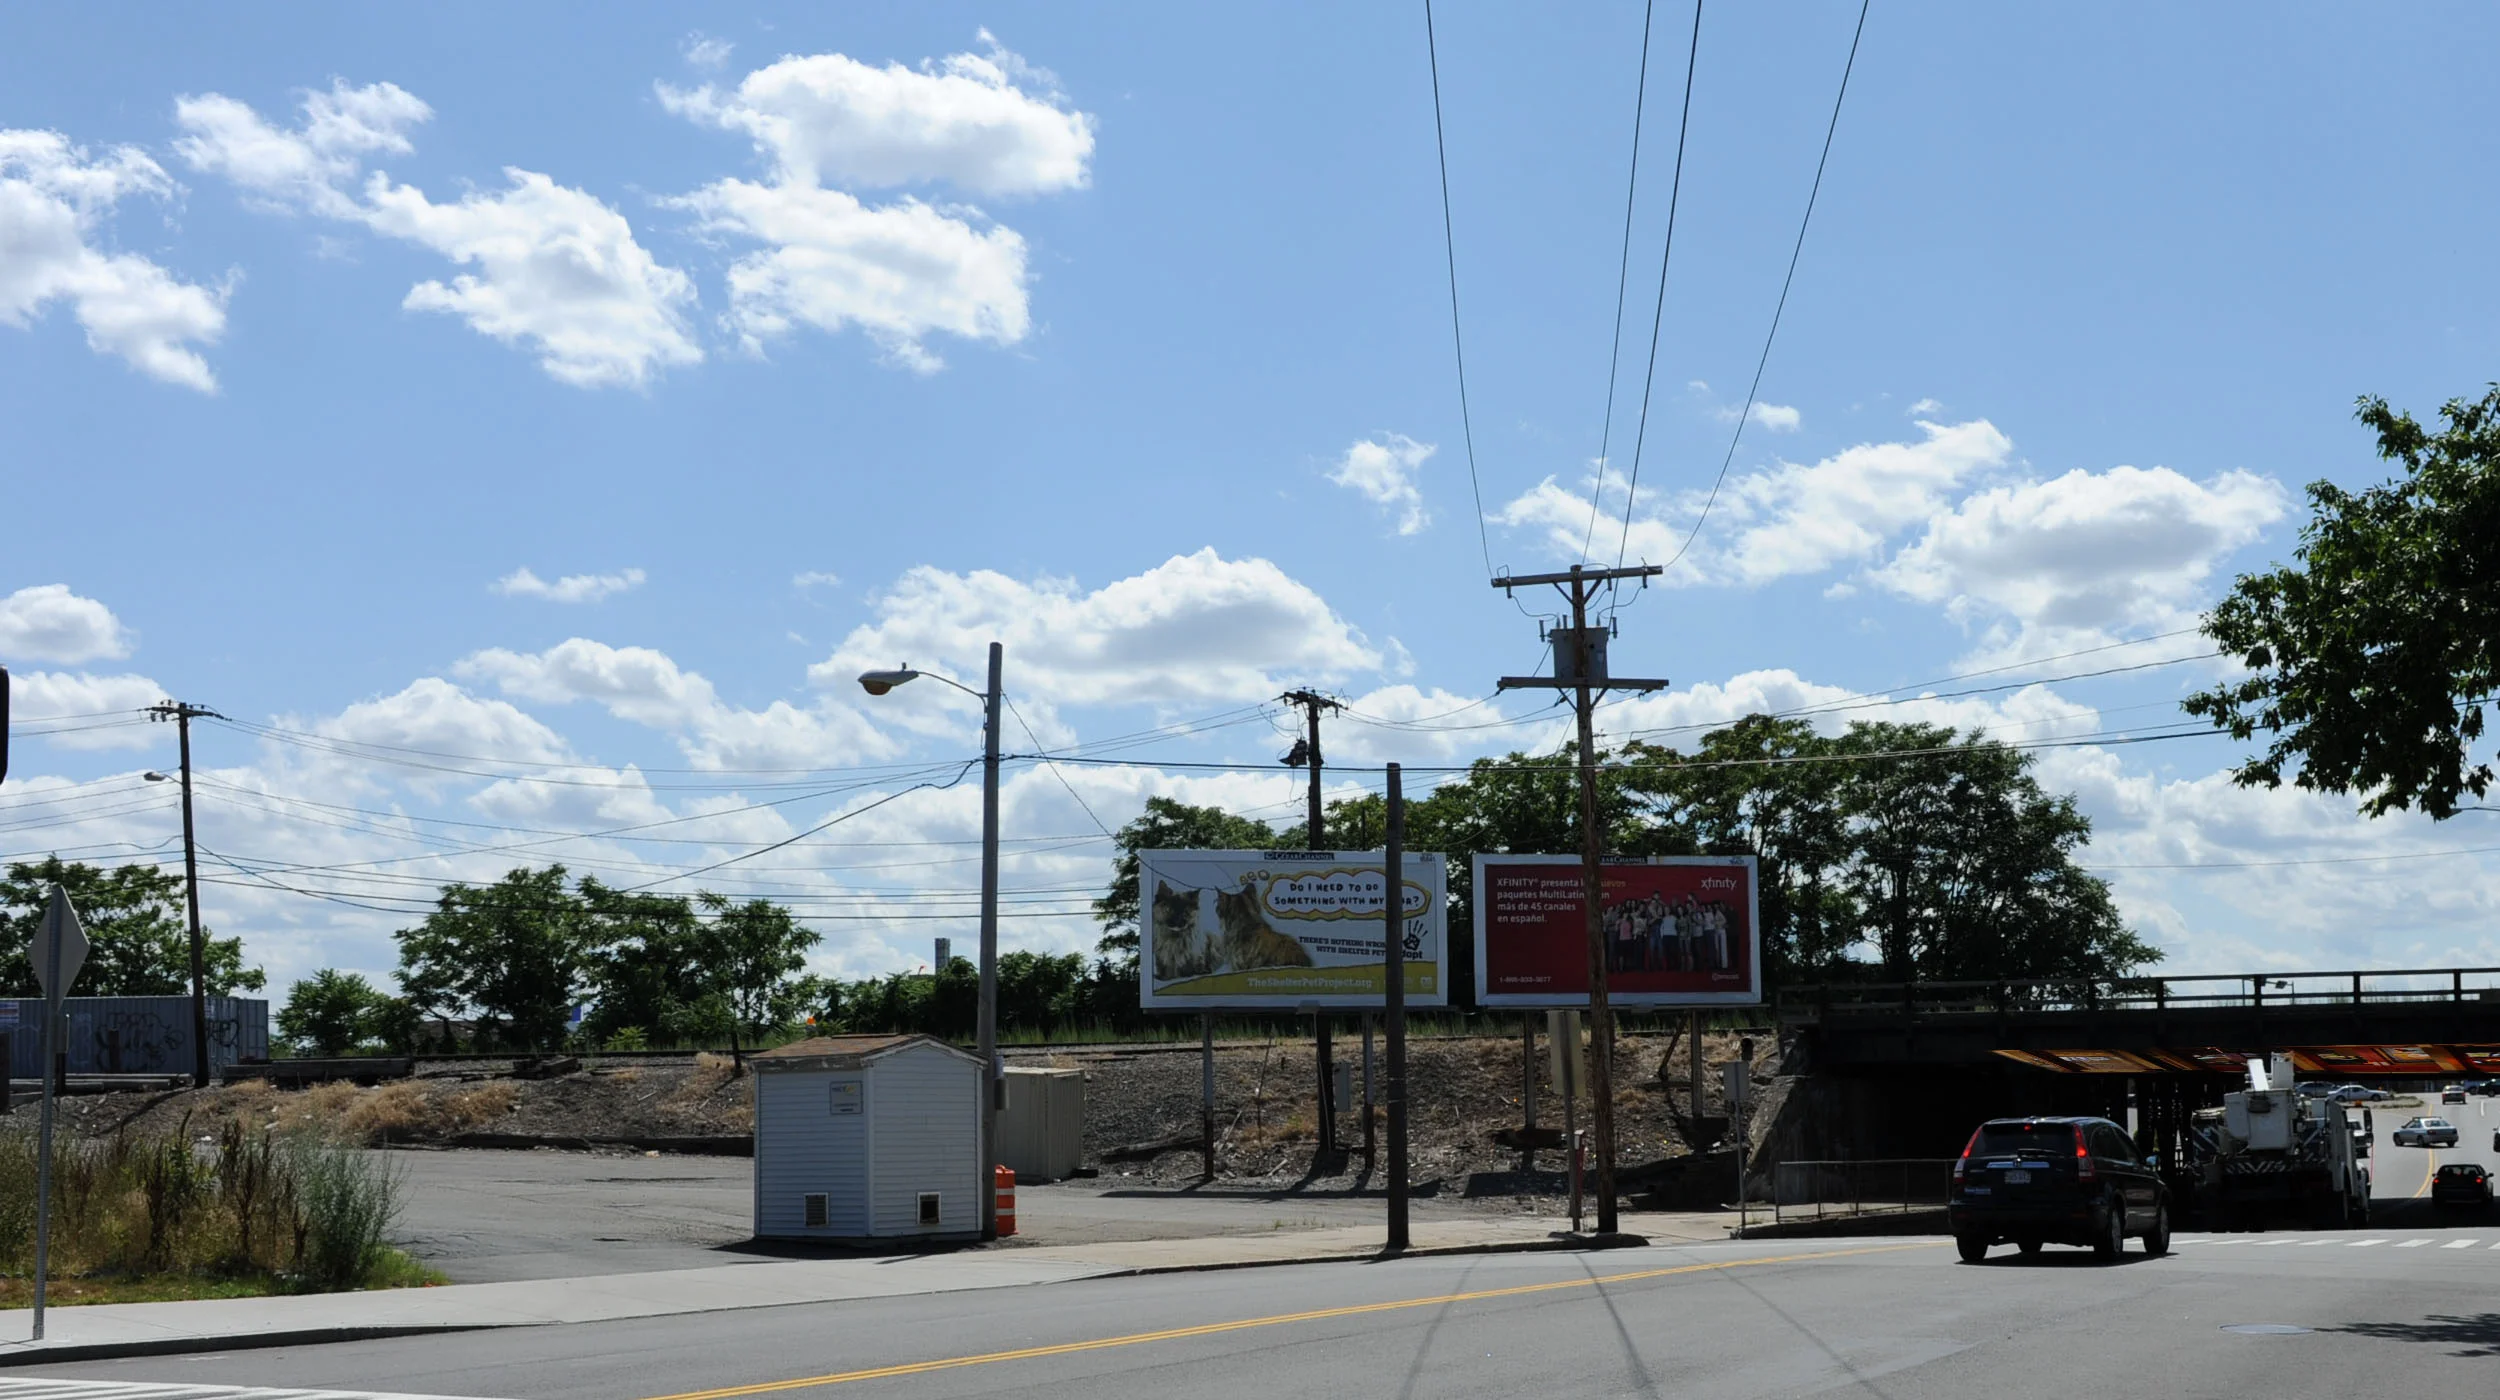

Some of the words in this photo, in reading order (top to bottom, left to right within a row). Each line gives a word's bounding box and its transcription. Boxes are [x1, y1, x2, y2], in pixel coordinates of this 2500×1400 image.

[1316, 882, 1343, 892] NEED
[1349, 882, 1361, 892] TO
[1541, 878, 1579, 889] presenta
[1600, 880, 1627, 888] uevos
[1700, 877, 1738, 890] xfinity
[1497, 891, 1538, 901] paquetes
[1539, 889, 1585, 899] MultiLatin
[1274, 896, 1335, 905] SOMETHING
[1339, 896, 1366, 905] WITH
[1369, 896, 1385, 905] MY
[1497, 902, 1516, 911] más
[1517, 902, 1529, 911] de
[1530, 902, 1542, 911] 45
[1543, 902, 1576, 911] canales
[1497, 915, 1509, 923] en
[1331, 938, 1364, 947] NOTHING
[1316, 945, 1337, 954] WITH
[1338, 947, 1370, 956] SHELTER
[1372, 949, 1387, 957] PET
[1400, 950, 1423, 961] dopt
[1247, 976, 1373, 990] TheShelterPetProject.org
